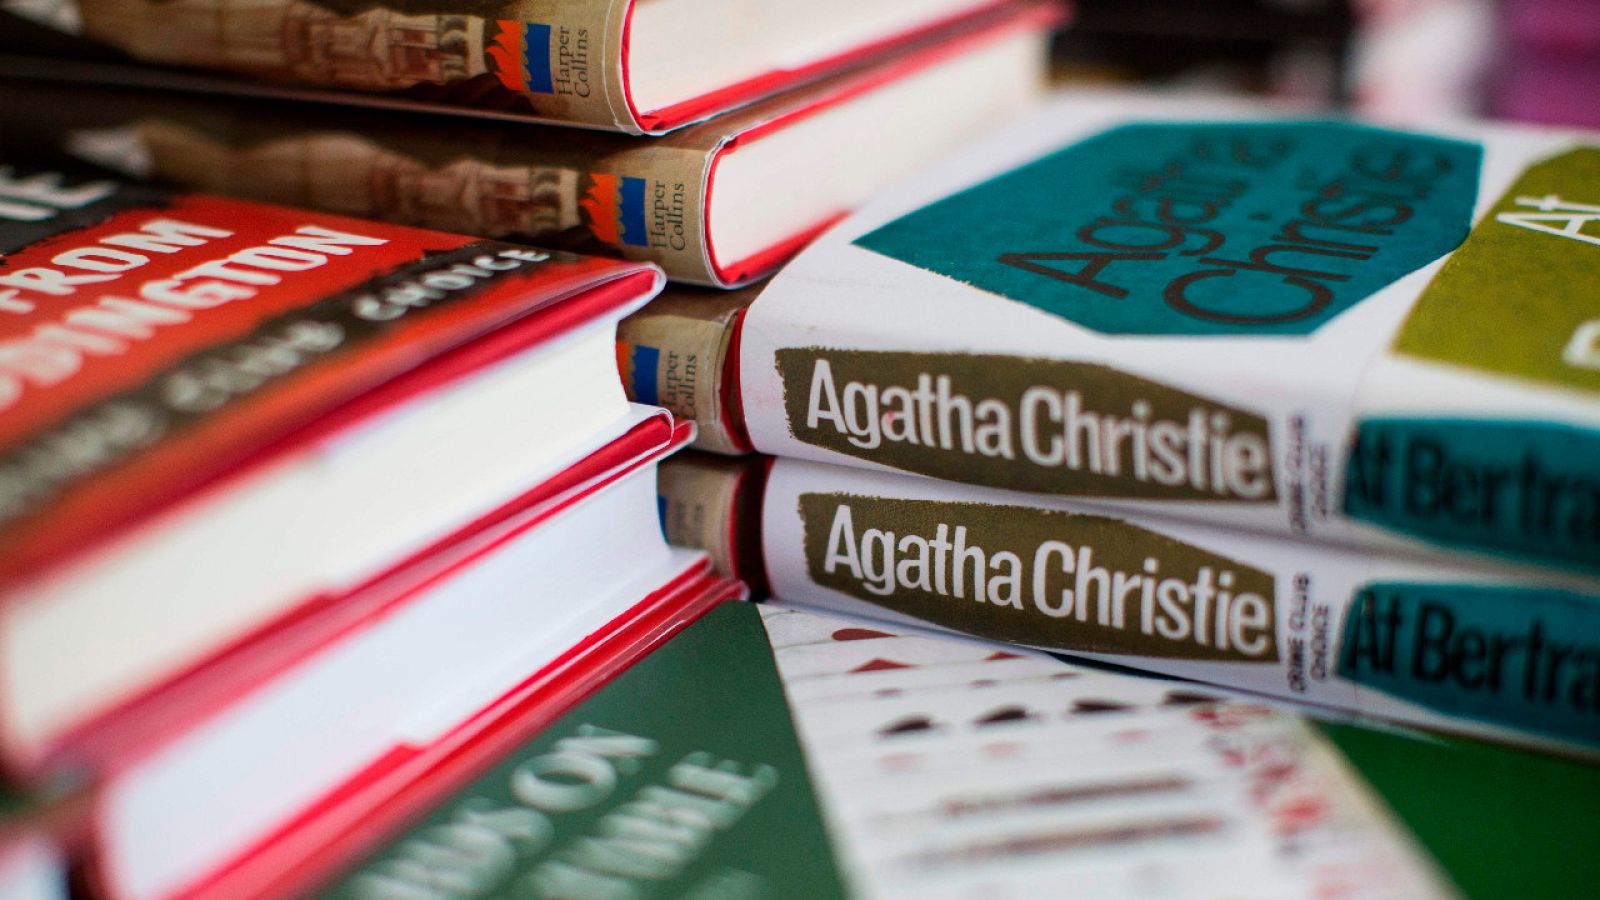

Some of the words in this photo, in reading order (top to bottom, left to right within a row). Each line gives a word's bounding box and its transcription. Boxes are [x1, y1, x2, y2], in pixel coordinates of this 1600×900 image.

[558, 26, 575, 96] Harper
[575, 28, 591, 98] Collins
[650, 180, 669, 249] Harper
[669, 182, 686, 251] Collins
[997, 132, 1300, 298] Agatha
[1161, 146, 1457, 324] Christie
[1495, 195, 1600, 247] At
[351, 246, 551, 322] CHOICE
[806, 358, 1016, 450] Agatha
[1019, 385, 1272, 498] Christie
[824, 504, 1026, 612] Agatha
[1032, 540, 1272, 657] Christie
[1345, 590, 1403, 674] At
[511, 723, 661, 813] ON
